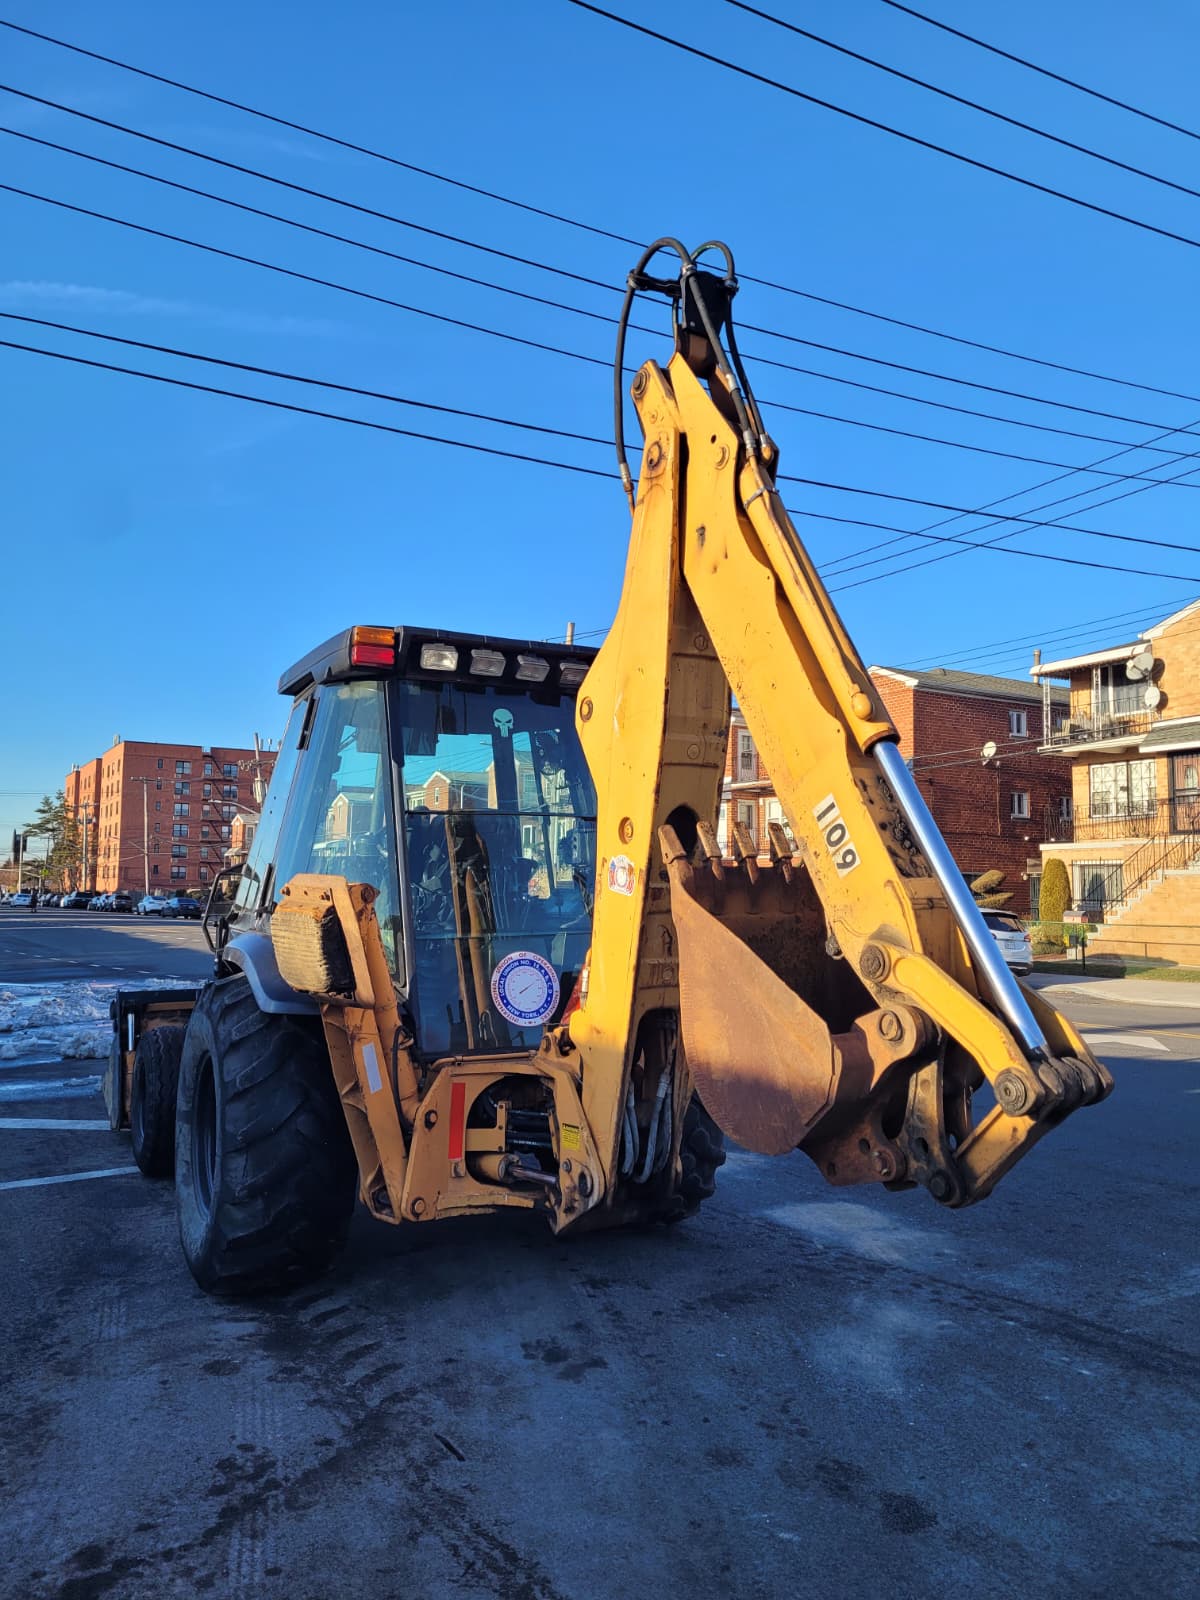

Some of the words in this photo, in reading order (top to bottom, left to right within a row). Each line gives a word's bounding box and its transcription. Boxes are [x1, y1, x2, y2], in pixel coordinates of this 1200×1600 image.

[816, 801, 857, 870] 109
[496, 956, 513, 973] UNION
[503, 961, 519, 976] UNION
[533, 955, 557, 983] OPERATING
[492, 979, 519, 1023] INTERNATIONAL
[507, 1005, 521, 1016] NEW
[541, 990, 559, 1021] ENGINEERS
